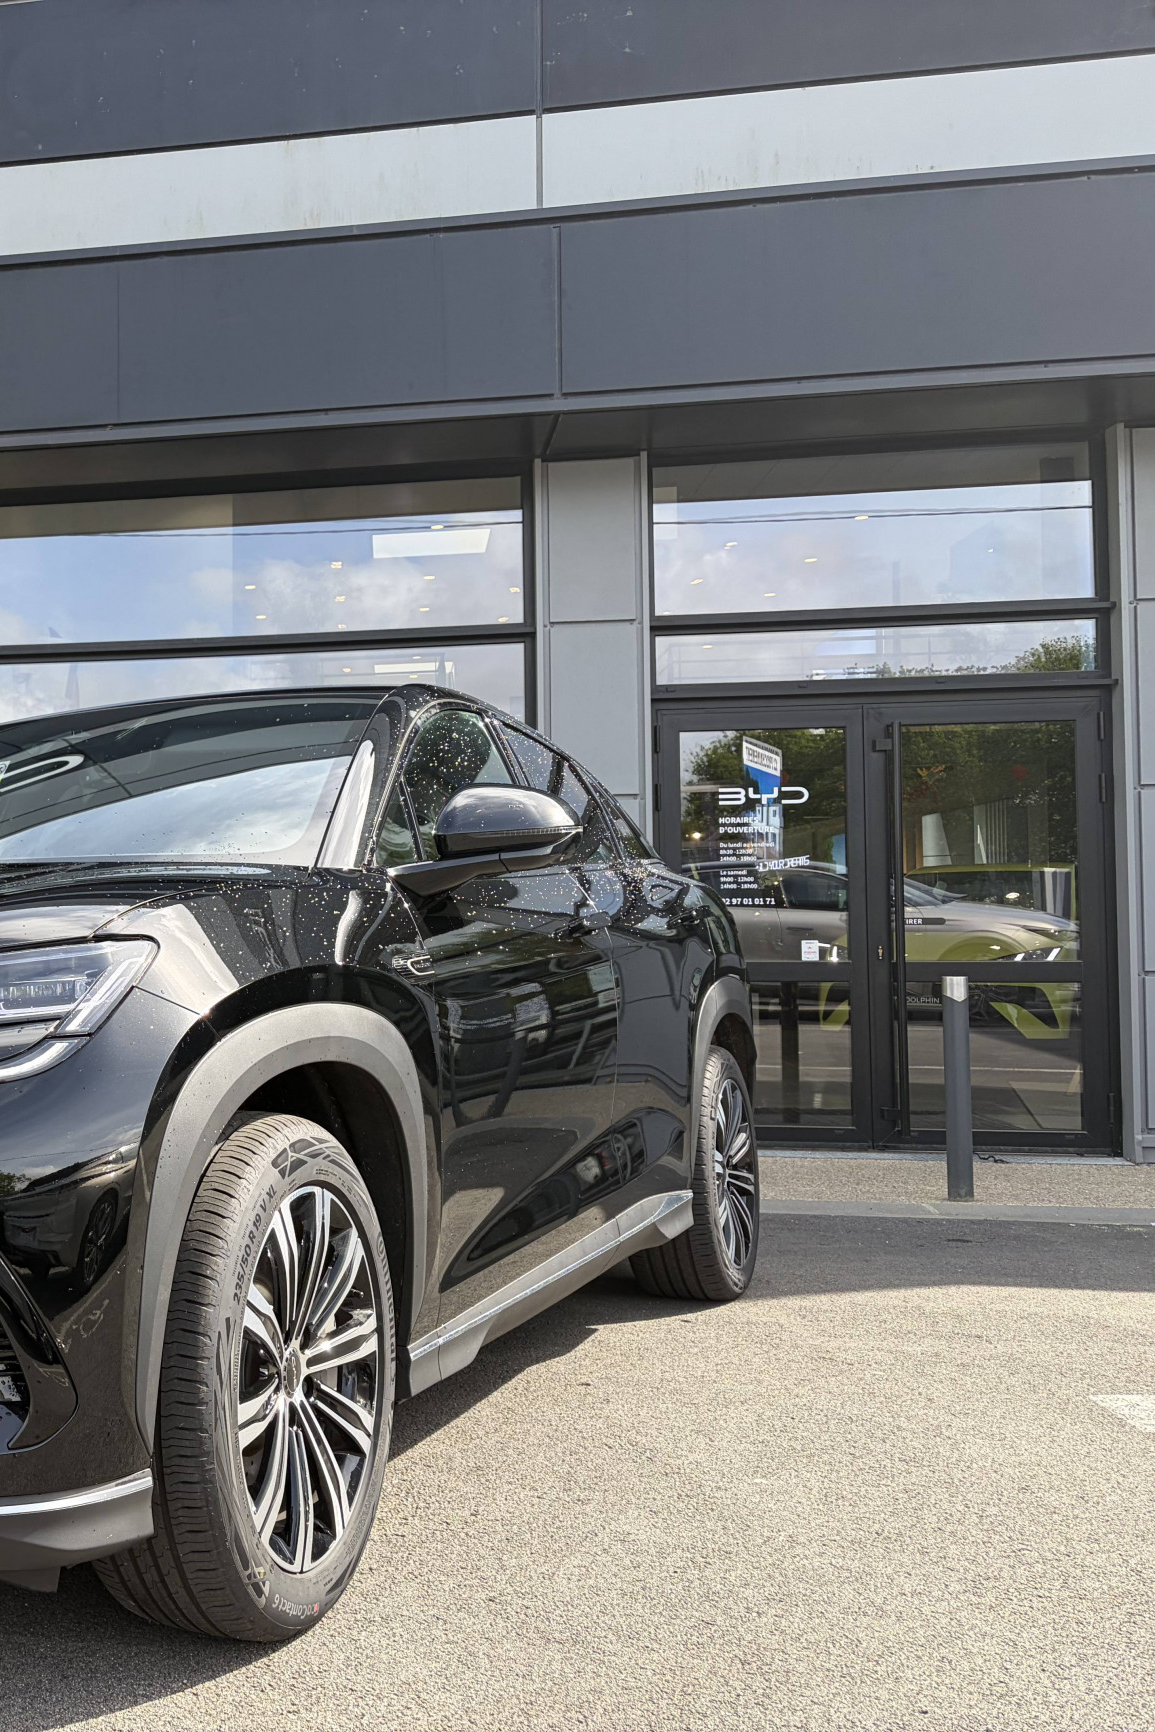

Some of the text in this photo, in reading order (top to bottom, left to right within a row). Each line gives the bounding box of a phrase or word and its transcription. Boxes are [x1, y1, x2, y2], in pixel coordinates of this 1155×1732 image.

[718, 786, 810, 805] BYD
[719, 826, 775, 834] D'OUVERTURE
[233, 1243, 253, 1306] 235/50
[259, 1200, 267, 1214] V
[266, 1184, 277, 1200] XL
[376, 1230, 396, 1363] Continental
[272, 1593, 280, 1608] 6
